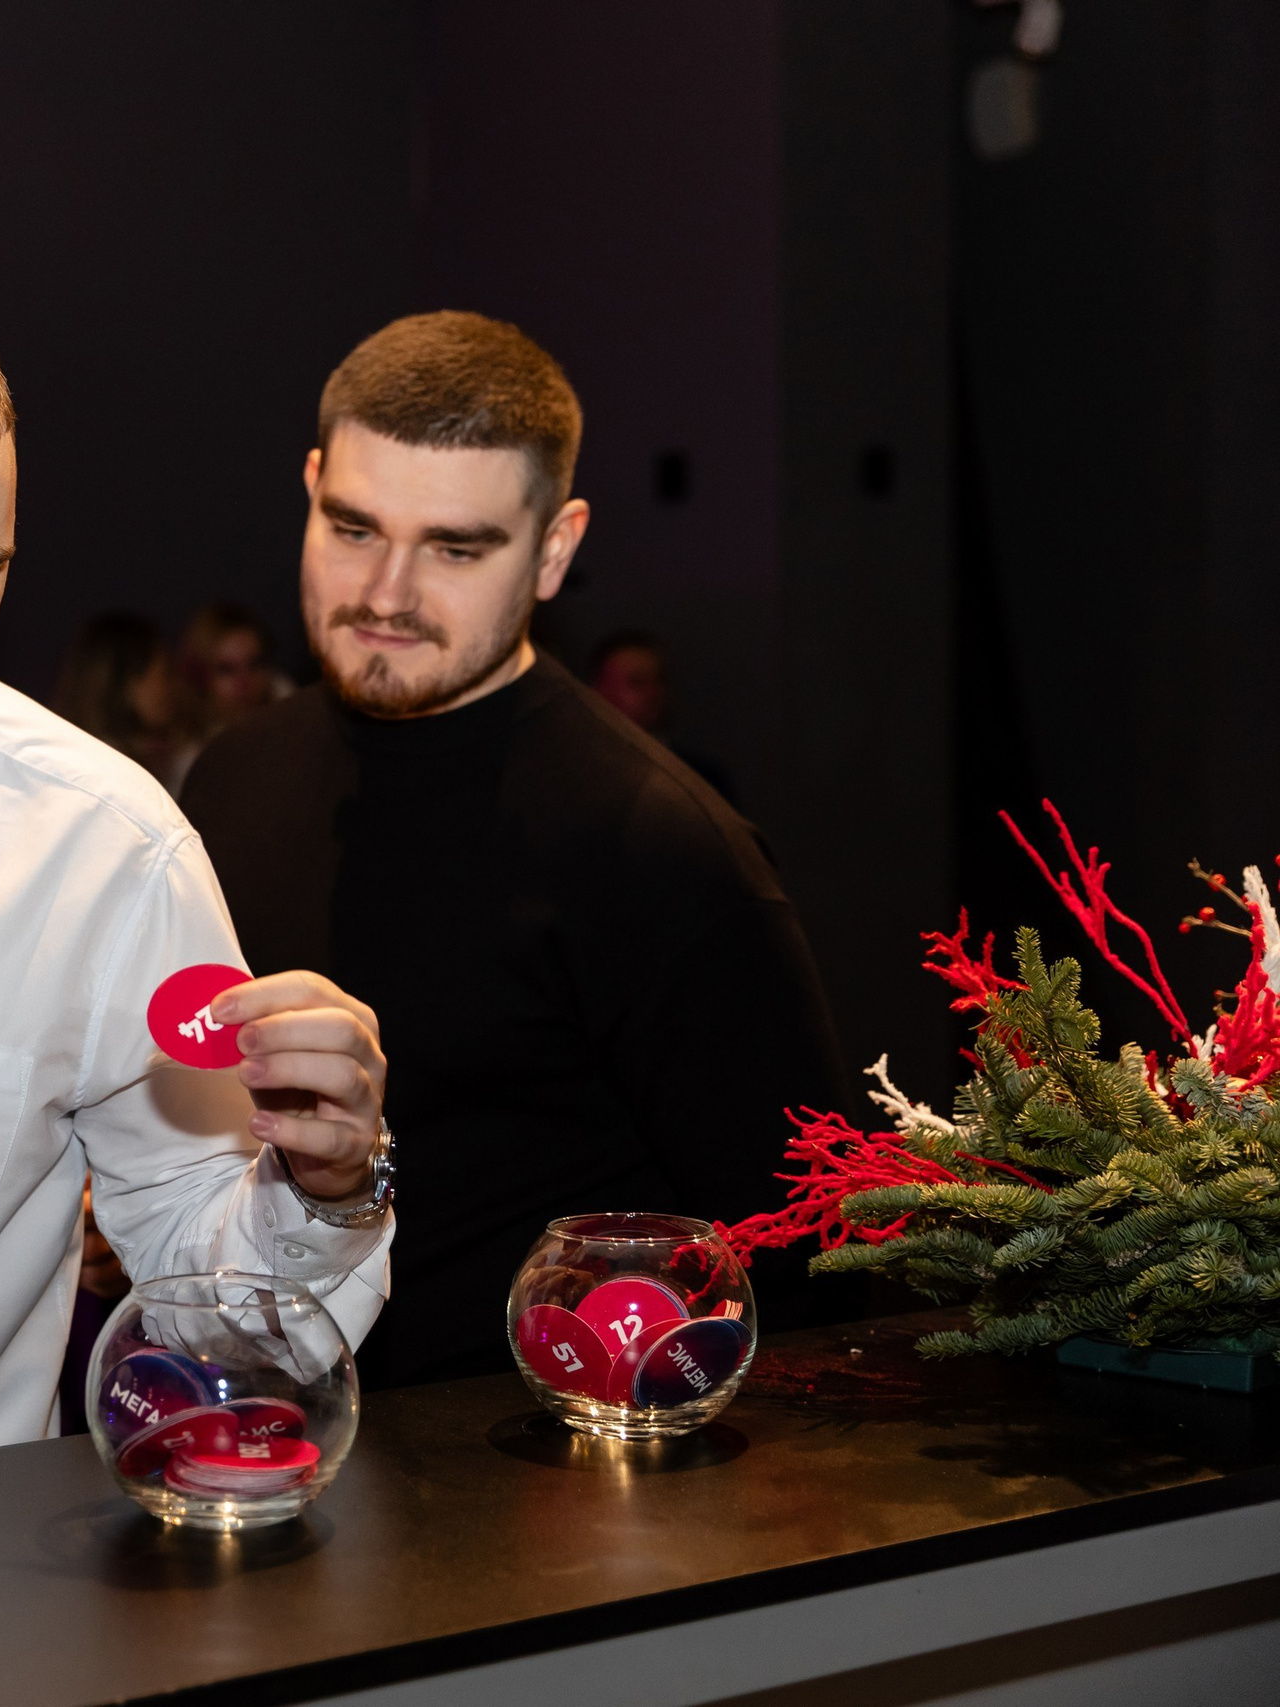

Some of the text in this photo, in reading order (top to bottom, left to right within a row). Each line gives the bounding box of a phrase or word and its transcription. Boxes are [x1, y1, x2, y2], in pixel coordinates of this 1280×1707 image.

[178, 1004, 224, 1044] 24
[608, 1314, 644, 1345] 12
[551, 1341, 585, 1373] 51
[667, 1342, 713, 1394] МЕГАИС
[109, 1381, 170, 1425] МЕГА
